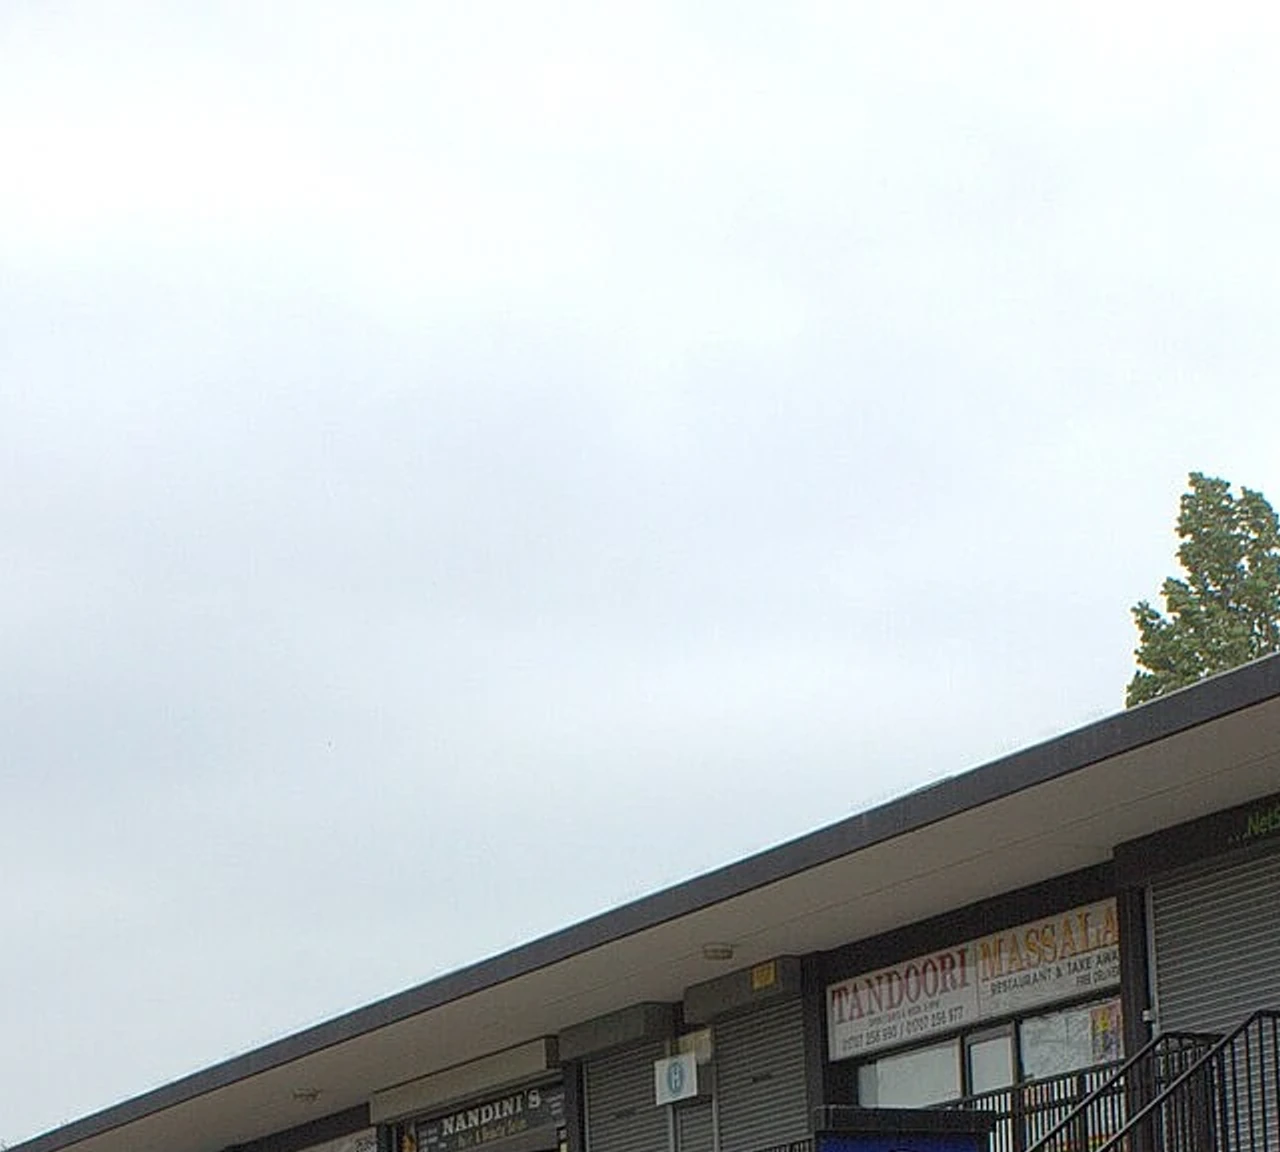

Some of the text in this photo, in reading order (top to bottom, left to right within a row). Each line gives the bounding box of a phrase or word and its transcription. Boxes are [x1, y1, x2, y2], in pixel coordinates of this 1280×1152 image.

[832, 906, 1118, 1025] TANDOORI MASSALA
[442, 1089, 542, 1136] NANDINI'S
